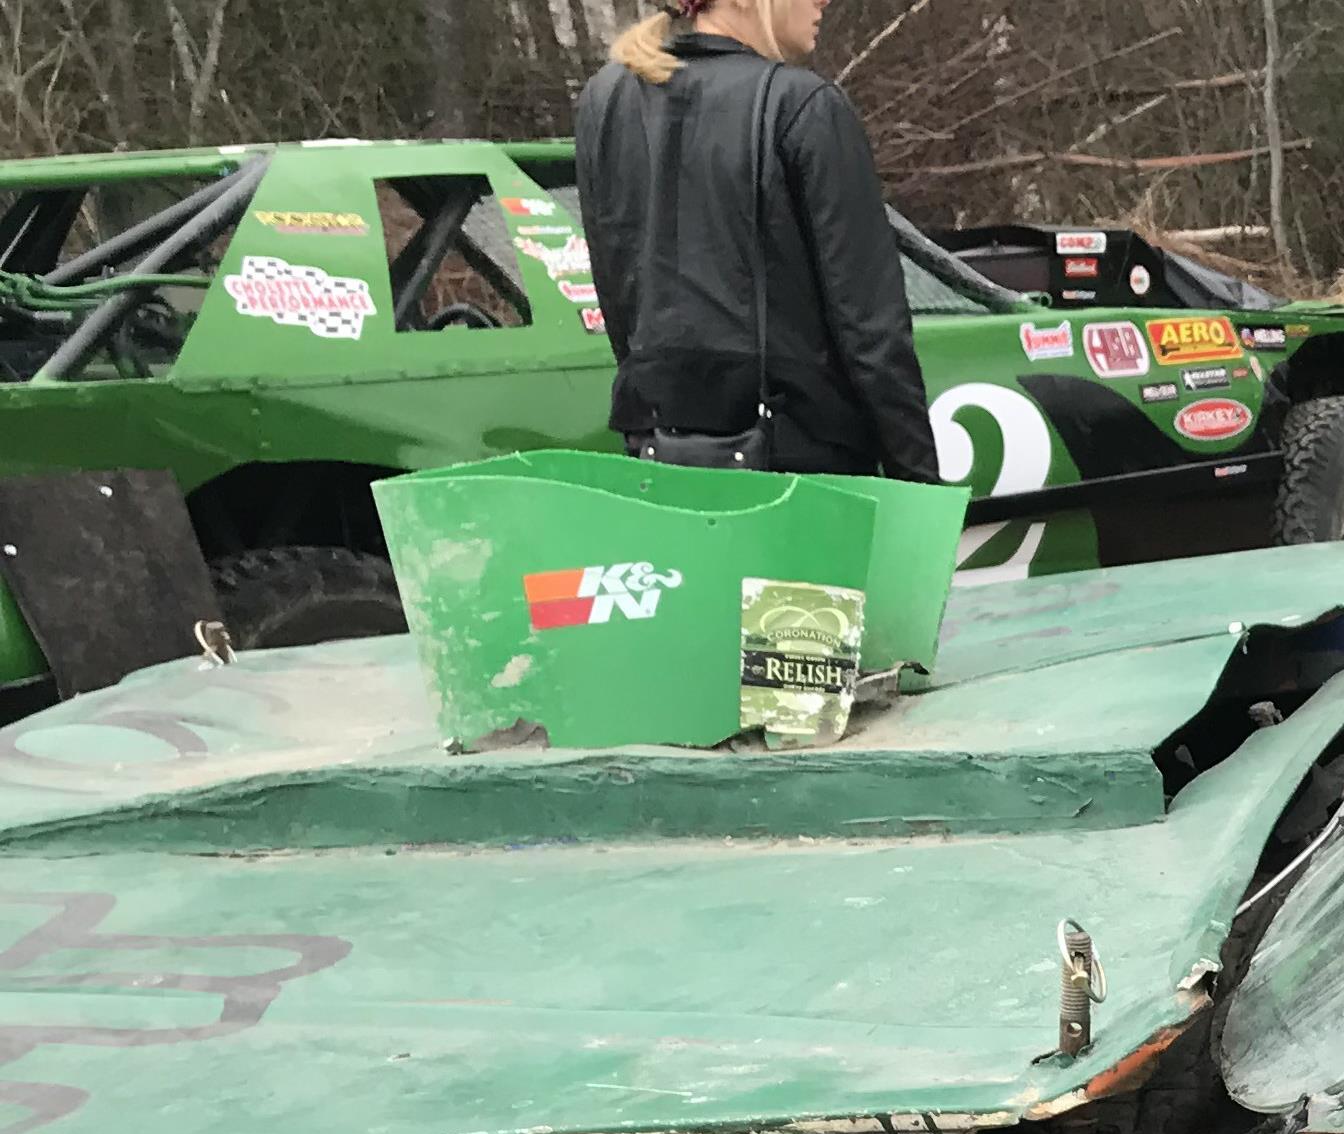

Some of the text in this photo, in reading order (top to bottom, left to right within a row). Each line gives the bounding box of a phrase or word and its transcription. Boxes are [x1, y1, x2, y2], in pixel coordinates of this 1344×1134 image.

[231, 279, 316, 300] CHOLETTE
[246, 294, 370, 312] PERFORMANCE
[1160, 321, 1226, 345] AERO
[577, 561, 682, 624] K&N
[766, 628, 842, 650] CORONATION
[764, 656, 843, 687] RELISH
